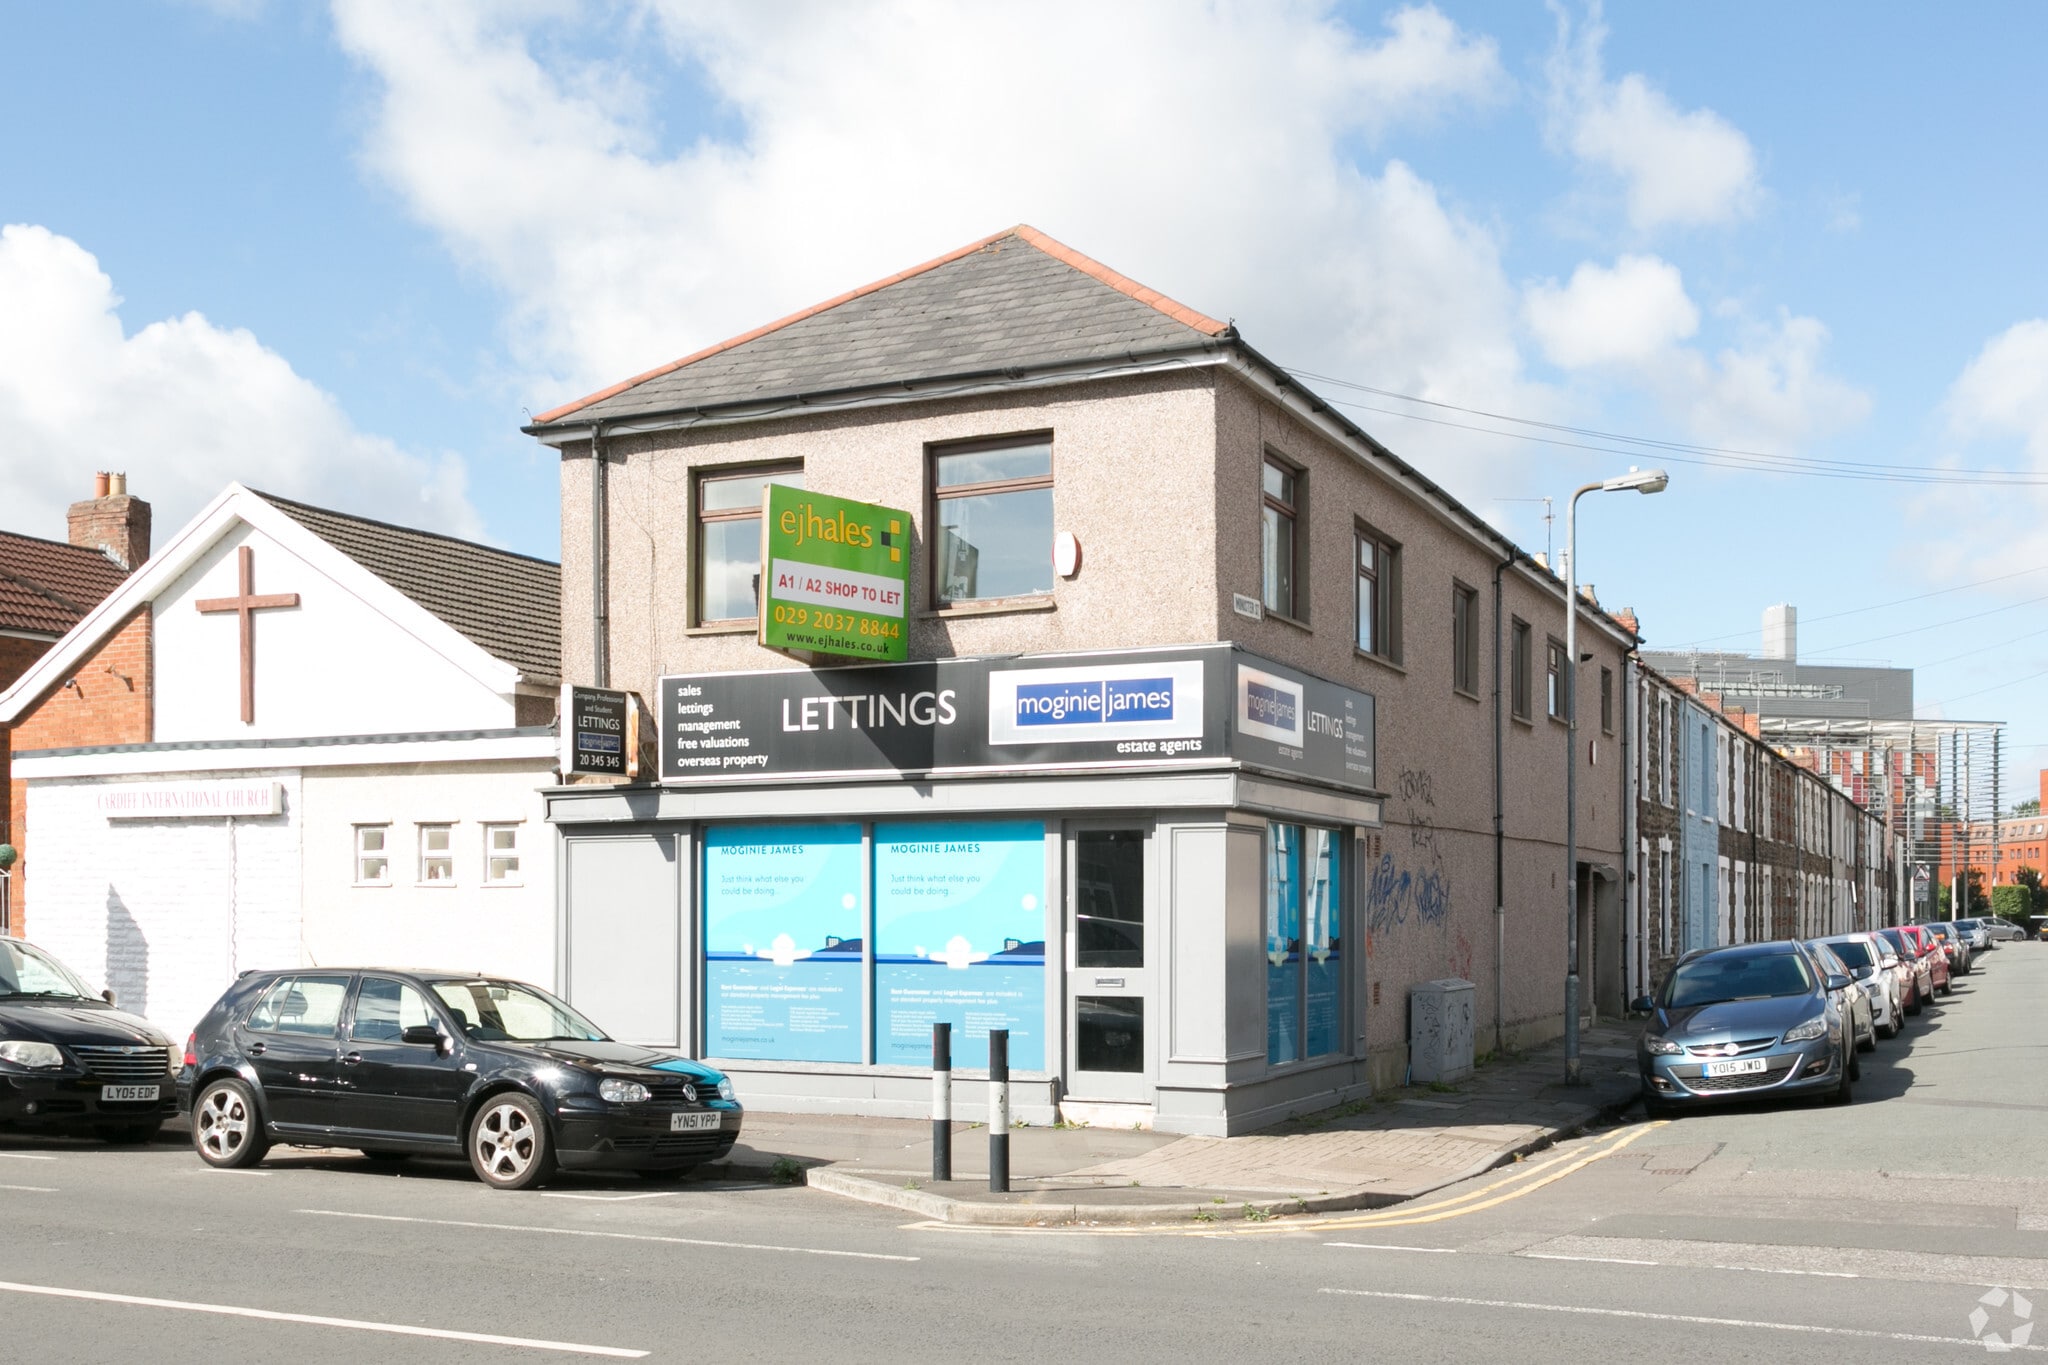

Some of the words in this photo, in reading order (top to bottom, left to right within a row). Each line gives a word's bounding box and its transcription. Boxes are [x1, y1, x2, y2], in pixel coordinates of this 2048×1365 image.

[780, 503, 873, 548] ejhales
[778, 574, 794, 589] A1
[805, 578, 822, 592] A2
[825, 580, 858, 598] SHOP
[861, 586, 877, 601] TO
[880, 589, 901, 605] LET
[774, 605, 808, 625] 029
[813, 610, 855, 632] 2037
[860, 618, 900, 639] 8844
[786, 632, 889, 654] www.ejhales.co.uk
[678, 684, 702, 697] sales
[678, 702, 714, 717] lettings
[782, 689, 957, 732] LETTINGS
[1018, 688, 1101, 720] moginie
[1106, 687, 1171, 717] james
[578, 715, 620, 730] LETTINGS
[678, 719, 741, 734] management
[1307, 710, 1343, 739] LETTINGS
[677, 737, 698, 750] free
[700, 736, 750, 749] valuations
[1116, 741, 1157, 753] estate
[1159, 739, 1202, 755] agents
[580, 754, 589, 766] 20
[590, 755, 604, 767] 345
[606, 756, 620, 768] 345
[677, 756, 721, 767] overseas
[723, 754, 769, 769] property
[98, 792, 137, 810] CARDIFF
[142, 790, 222, 809] INTERNATIONAL
[226, 789, 269, 808] CHURCH
[720, 845, 767, 855] MOGINIE
[770, 845, 804, 854] JAMES
[890, 844, 940, 854] MOGINIE
[944, 843, 981, 853] JAMES
[736, 875, 752, 884] think
[755, 875, 772, 884] what
[774, 875, 789, 884] else
[791, 876, 804, 885] you
[891, 874, 905, 884] Just
[907, 874, 924, 884] think
[927, 874, 946, 883] what
[948, 874, 964, 883] else
[966, 875, 981, 885] you
[721, 887, 741, 896] could
[742, 887, 752, 896] be
[890, 887, 912, 896] could
[914, 887, 925, 896] be
[1740, 1060, 1761, 1072] JWD
[107, 1087, 136, 1099] LY05
[137, 1087, 156, 1099] EDF
[677, 1114, 698, 1128] YN51
[700, 1114, 717, 1128] YPP
